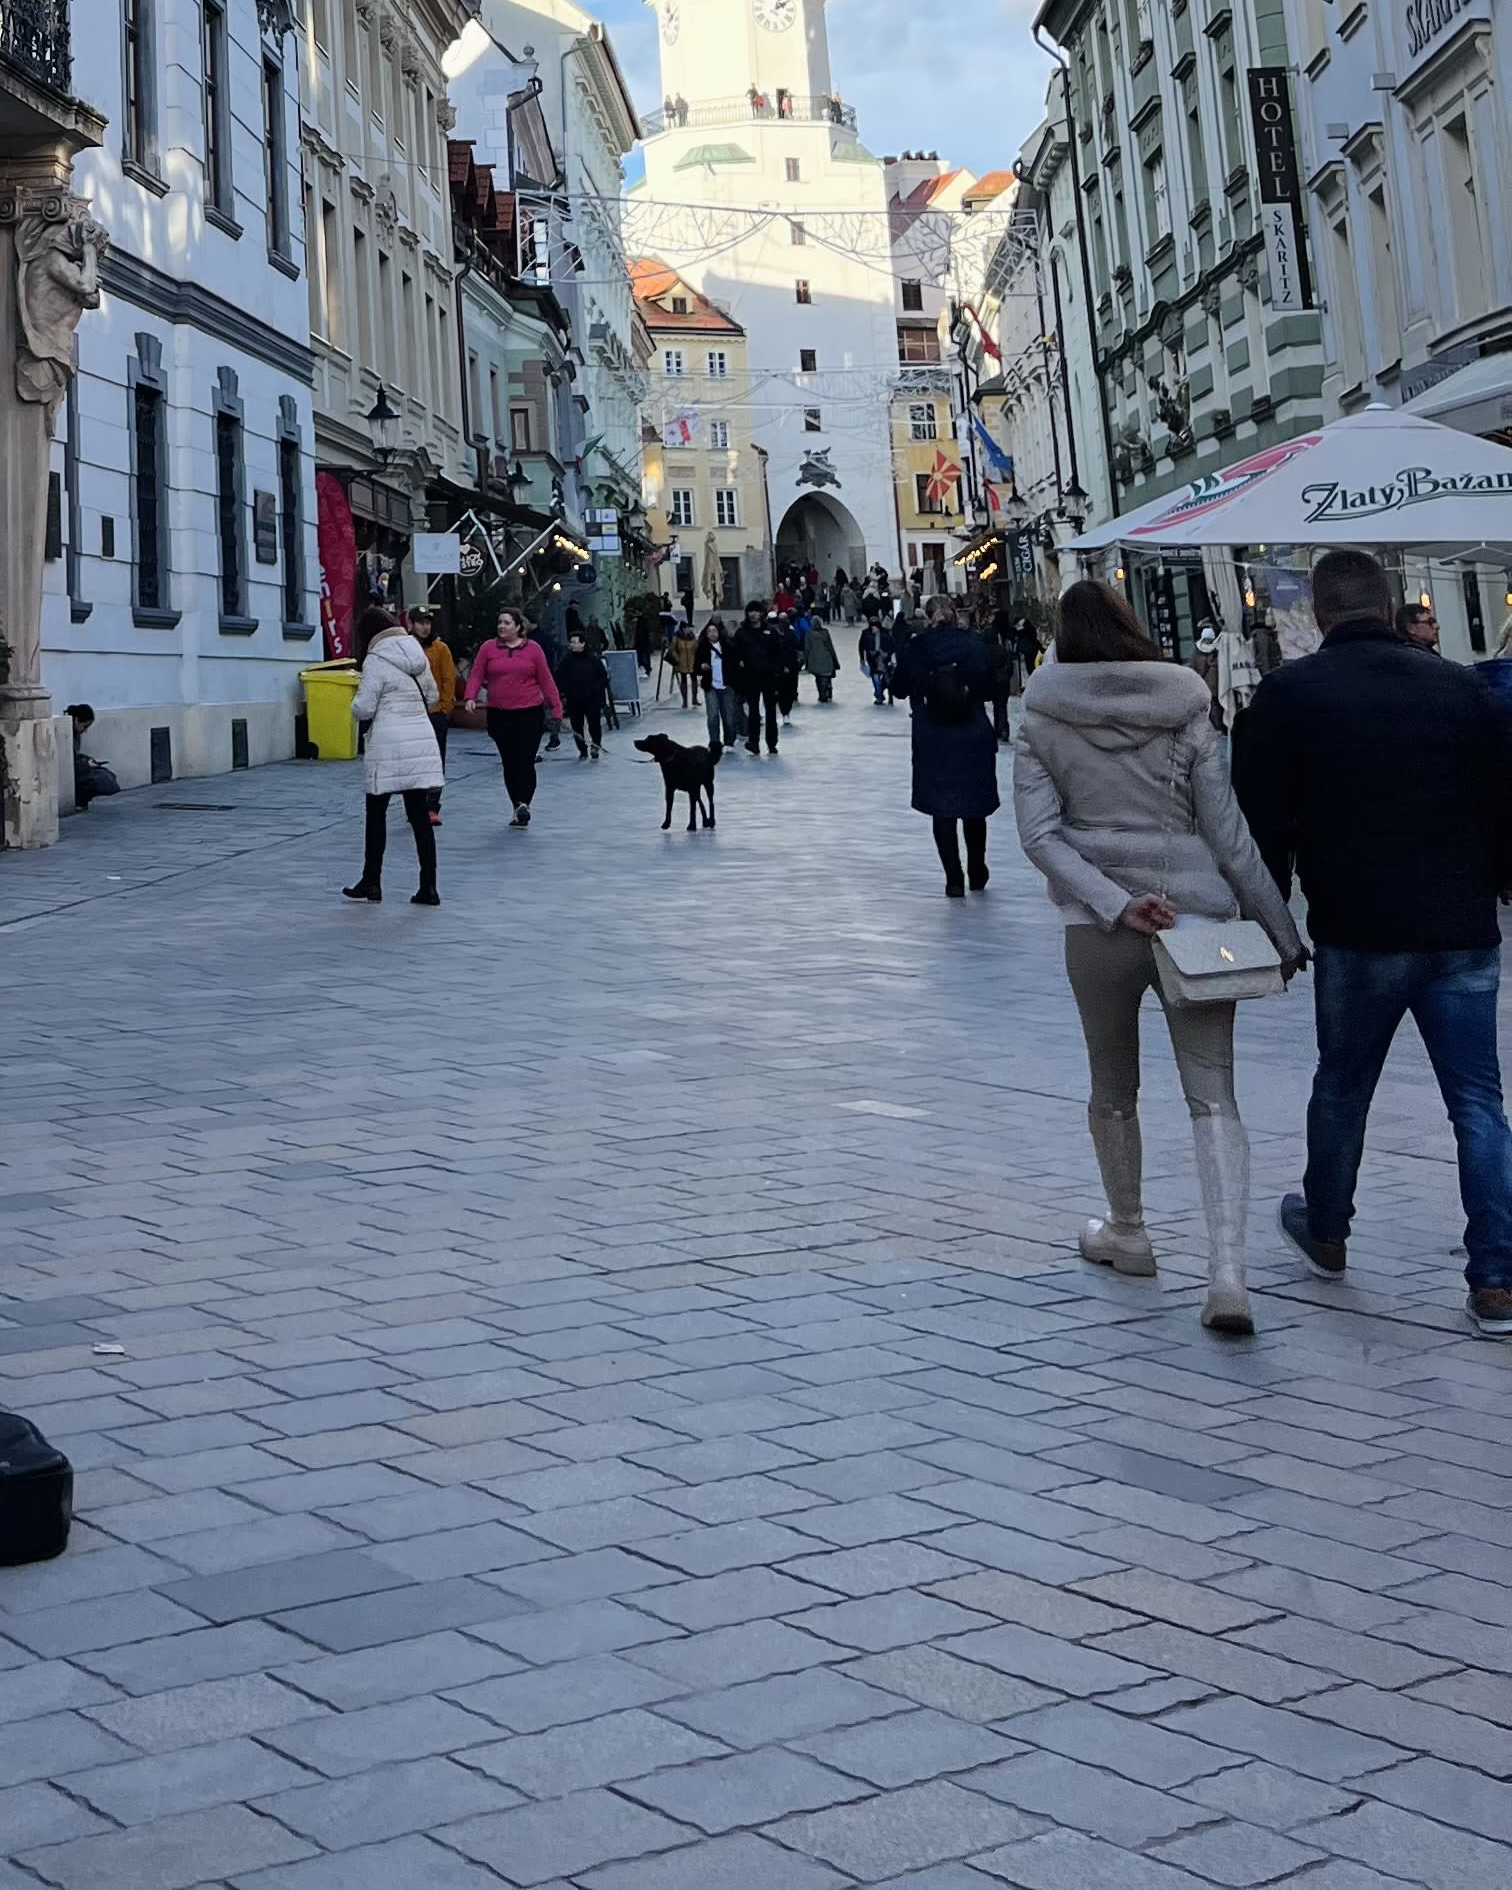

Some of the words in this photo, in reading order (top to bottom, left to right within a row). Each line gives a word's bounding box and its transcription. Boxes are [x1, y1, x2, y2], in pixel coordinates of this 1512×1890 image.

[1258, 77, 1291, 197] HOTEL
[1273, 210, 1294, 303] SKARITZ
[1302, 482, 1405, 524] Zlatý
[1396, 467, 1512, 510] Bažan
